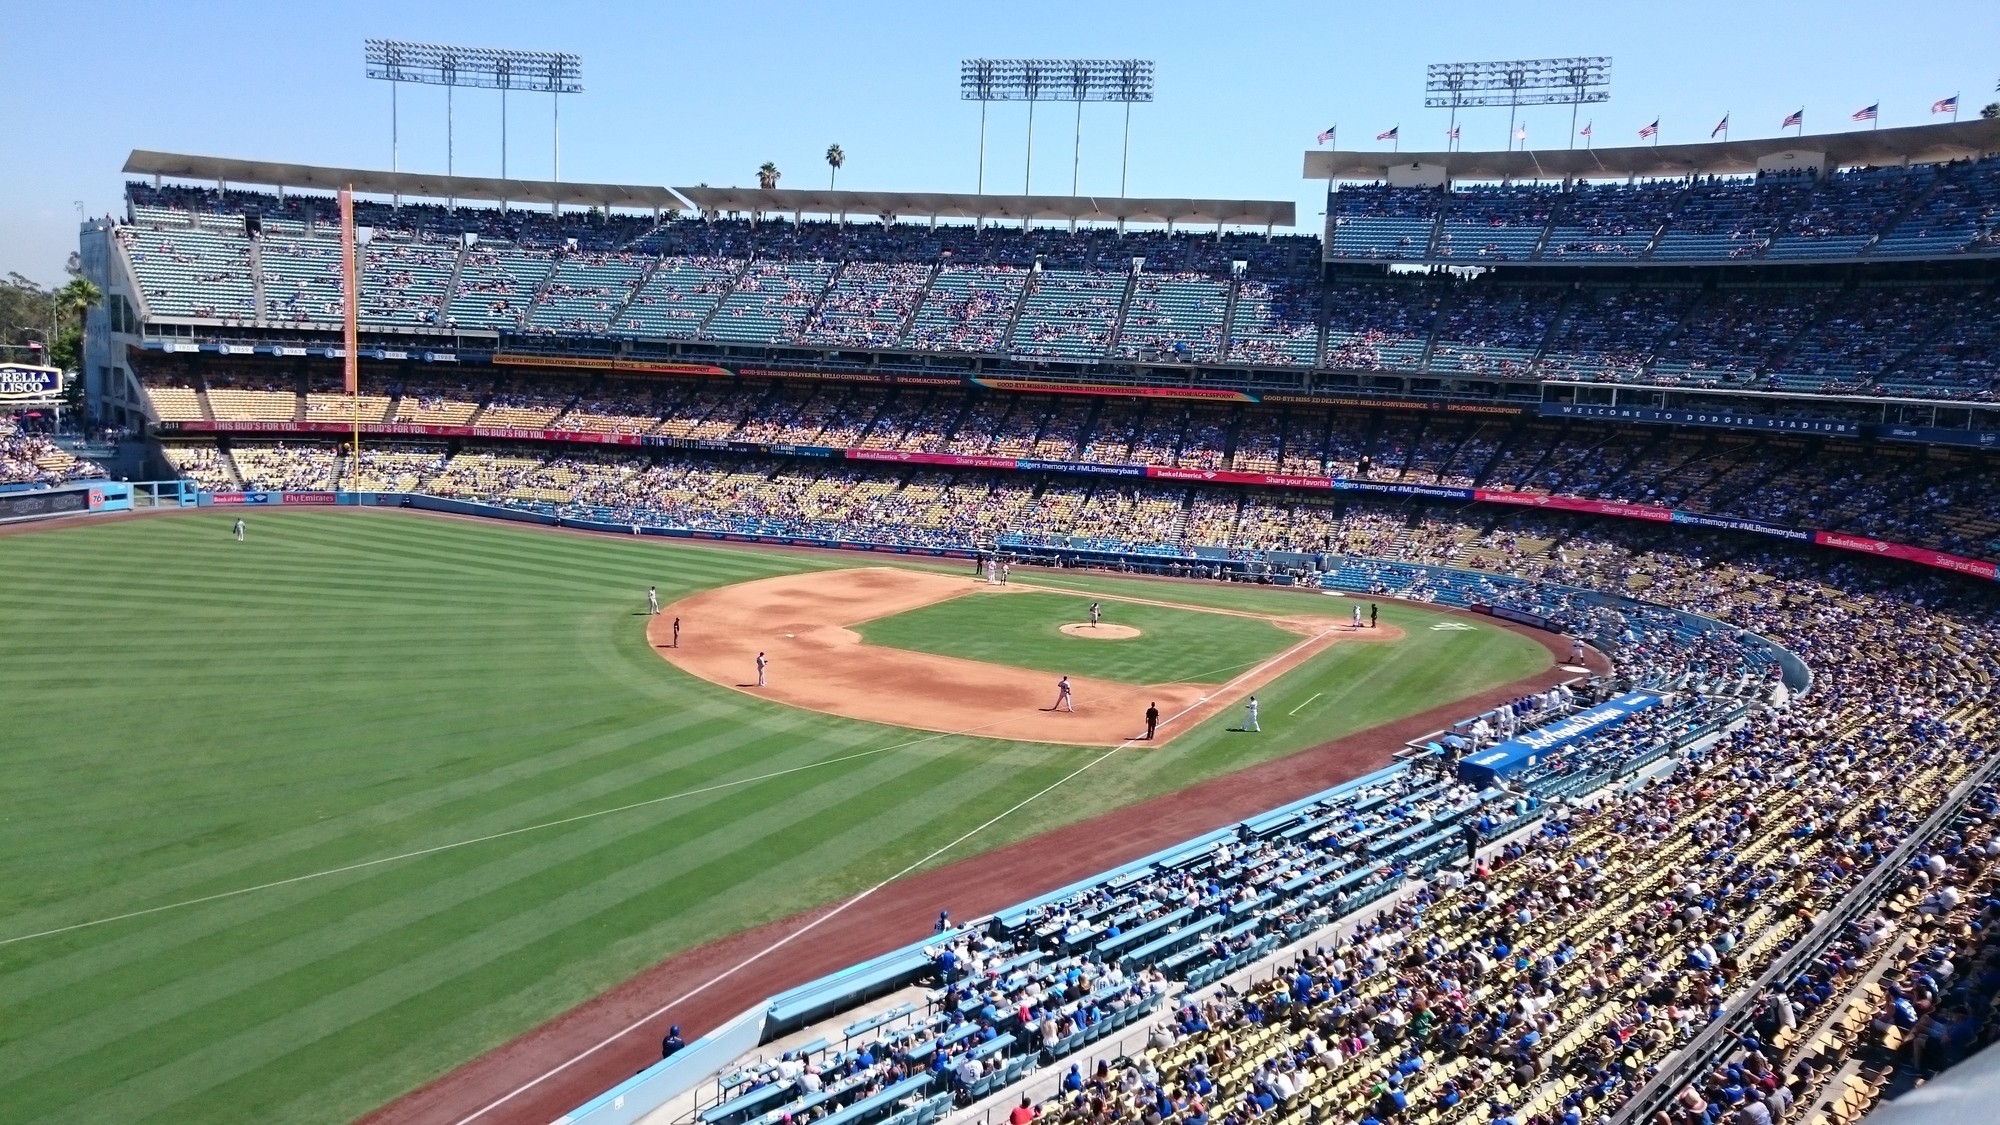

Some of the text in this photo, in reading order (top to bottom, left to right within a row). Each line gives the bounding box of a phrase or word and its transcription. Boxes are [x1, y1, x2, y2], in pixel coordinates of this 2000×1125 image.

[413, 327, 456, 336] CLUB
[0, 372, 51, 383] RELLA
[1563, 407, 1845, 431] WELCOME TO DODGER STADIUM
[214, 422, 233, 431] THIS
[235, 422, 261, 431] BUD'S
[262, 422, 279, 431] FOR
[280, 422, 300, 431] YOU.
[368, 424, 392, 433] BUD'S
[393, 425, 409, 433] FOR
[410, 425, 428, 434] YOU.
[472, 428, 489, 436] THIS
[491, 429, 513, 438] BUD'S
[514, 430, 529, 438] FOR
[530, 430, 546, 439] YOU.
[956, 457, 973, 465] Share
[989, 459, 1013, 467] favorite
[1015, 460, 1041, 469] Dodgers
[1077, 464, 1139, 475] #MLBmemorybank
[1178, 471, 1202, 479] America
[1265, 476, 1285, 484] Share
[1302, 478, 1329, 487] favorite
[1331, 480, 1358, 489] Dodgers
[1360, 483, 1387, 492] memory
[1398, 485, 1466, 498] #MLBmemorybank
[286, 495, 300, 503] Fly
[1602, 504, 1668, 519] Share your favorite
[1670, 512, 1699, 524] Dodgers
[1700, 517, 1728, 529] memory
[1739, 523, 1808, 540] #MLBmemorybank
[1827, 537, 1841, 546] Bank
[1850, 540, 1874, 551] America
[1937, 555, 1955, 567] Share
[1955, 560, 1970, 570] your
[1970, 562, 1993, 576] favorite
